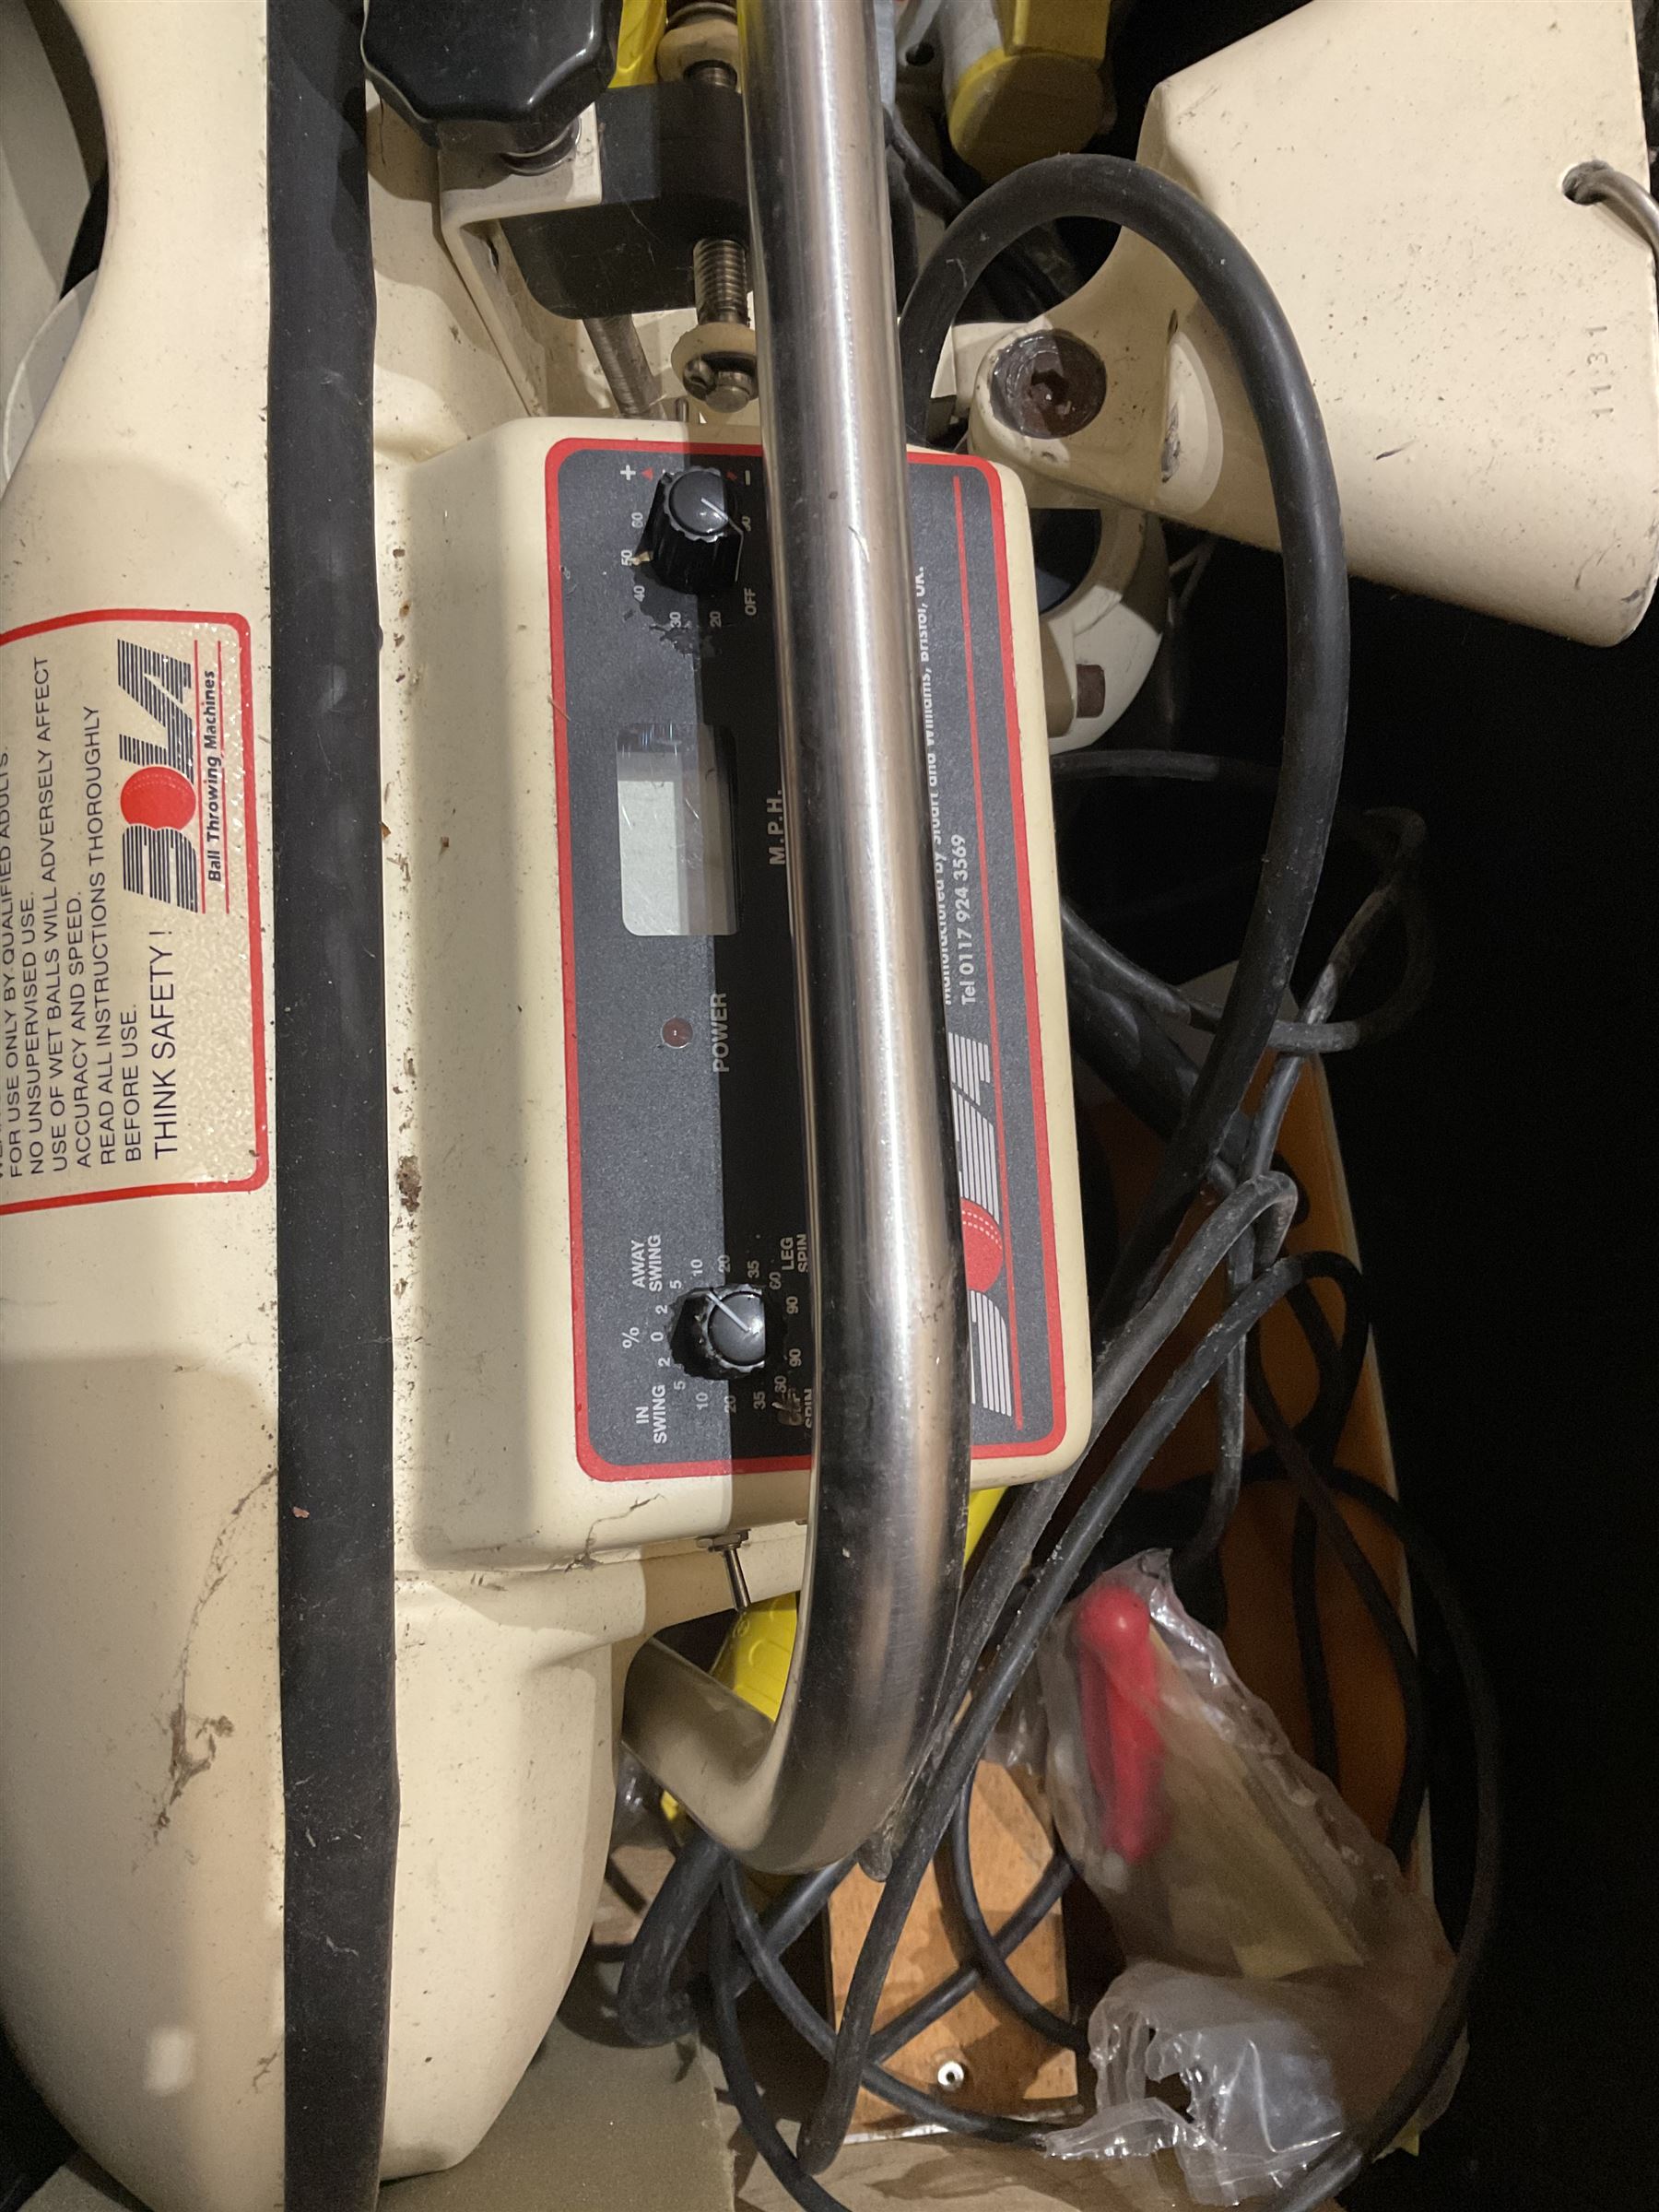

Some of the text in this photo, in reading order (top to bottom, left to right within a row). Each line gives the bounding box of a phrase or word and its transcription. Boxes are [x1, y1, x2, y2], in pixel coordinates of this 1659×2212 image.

[630, 512, 643, 529] 60
[621, 549, 632, 566] 50
[634, 585, 645, 602] 40
[744, 588, 757, 616] OFF
[669, 612, 682, 629] 30
[710, 610, 722, 628] 20
[116, 639, 198, 912] BOLA
[201, 671, 221, 882] Ball Throwing Machines
[767, 789, 785, 865] M.P.H.
[0, 845, 15, 965] QUALIFIED
[33, 656, 68, 1172] USE OF WET BALLS WILL ADVERSELY AFFECT
[951, 833, 976, 1005] Tel 0117 924 3569
[83, 706, 116, 1165] READ ALL INSTRUCTIONS THOROUGHLY
[2, 971, 17, 1001] BY
[149, 946, 176, 1060] SAFETY
[4, 1009, 18, 1068] ONLY
[20, 891, 44, 1175] NO UNSUPERVISED USE.
[66, 891, 92, 1168] ACCURACY AND SPEED.
[710, 994, 730, 1073] POWER
[120, 1004, 142, 1161] BEFORE USE.
[6, 1076, 20, 1123] USE
[151, 1069, 178, 1160] THINK
[9, 1129, 22, 1178] FOR
[630, 1240, 646, 1288] AWAY
[647, 1233, 663, 1292] SWING
[691, 1259, 702, 1277] 10
[718, 1254, 731, 1273] 20
[780, 1237, 794, 1270] LEG
[796, 1233, 808, 1273] SPIN
[669, 1279, 682, 1289] 5
[747, 1261, 759, 1278] 35
[655, 1304, 667, 1314] 2
[785, 1296, 799, 1314] 90
[621, 1326, 640, 1349] %
[651, 1331, 664, 1342] 0
[658, 1357, 670, 1367] 2
[789, 1347, 802, 1368] 90
[673, 1381, 686, 1390] 5
[753, 1391, 766, 1410] 35
[636, 1406, 649, 1424] IN
[653, 1384, 667, 1444] SWING
[697, 1392, 708, 1410] 10
[724, 1395, 735, 1413] 20
